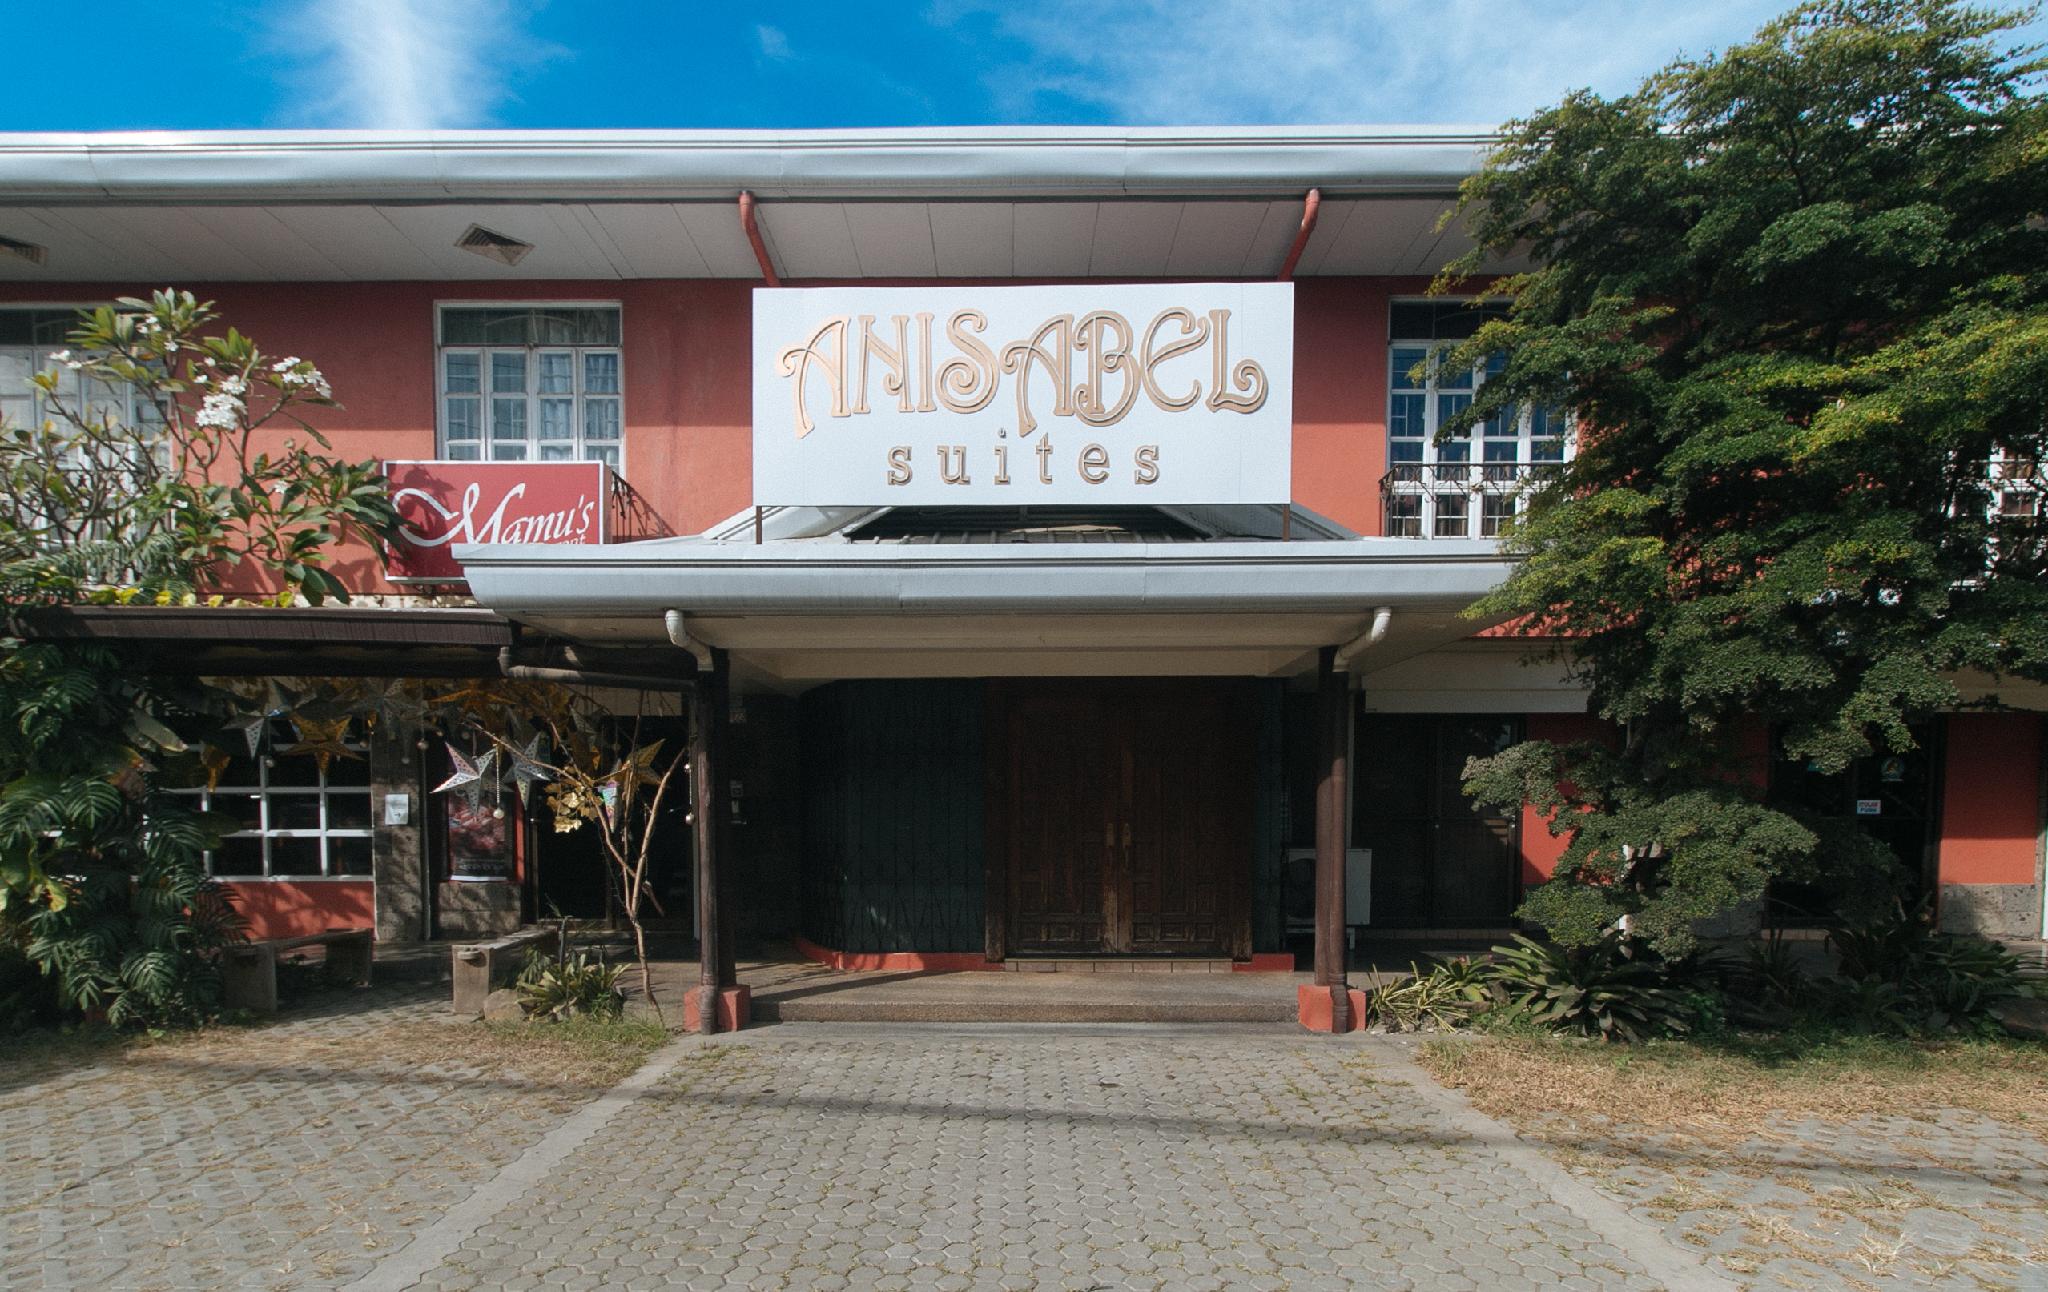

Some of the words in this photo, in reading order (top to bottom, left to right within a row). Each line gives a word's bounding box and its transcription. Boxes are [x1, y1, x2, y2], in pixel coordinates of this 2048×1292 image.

[777, 307, 1268, 437] ANISABEL
[886, 427, 1161, 486] suites
[392, 482, 595, 546] Mamu's
